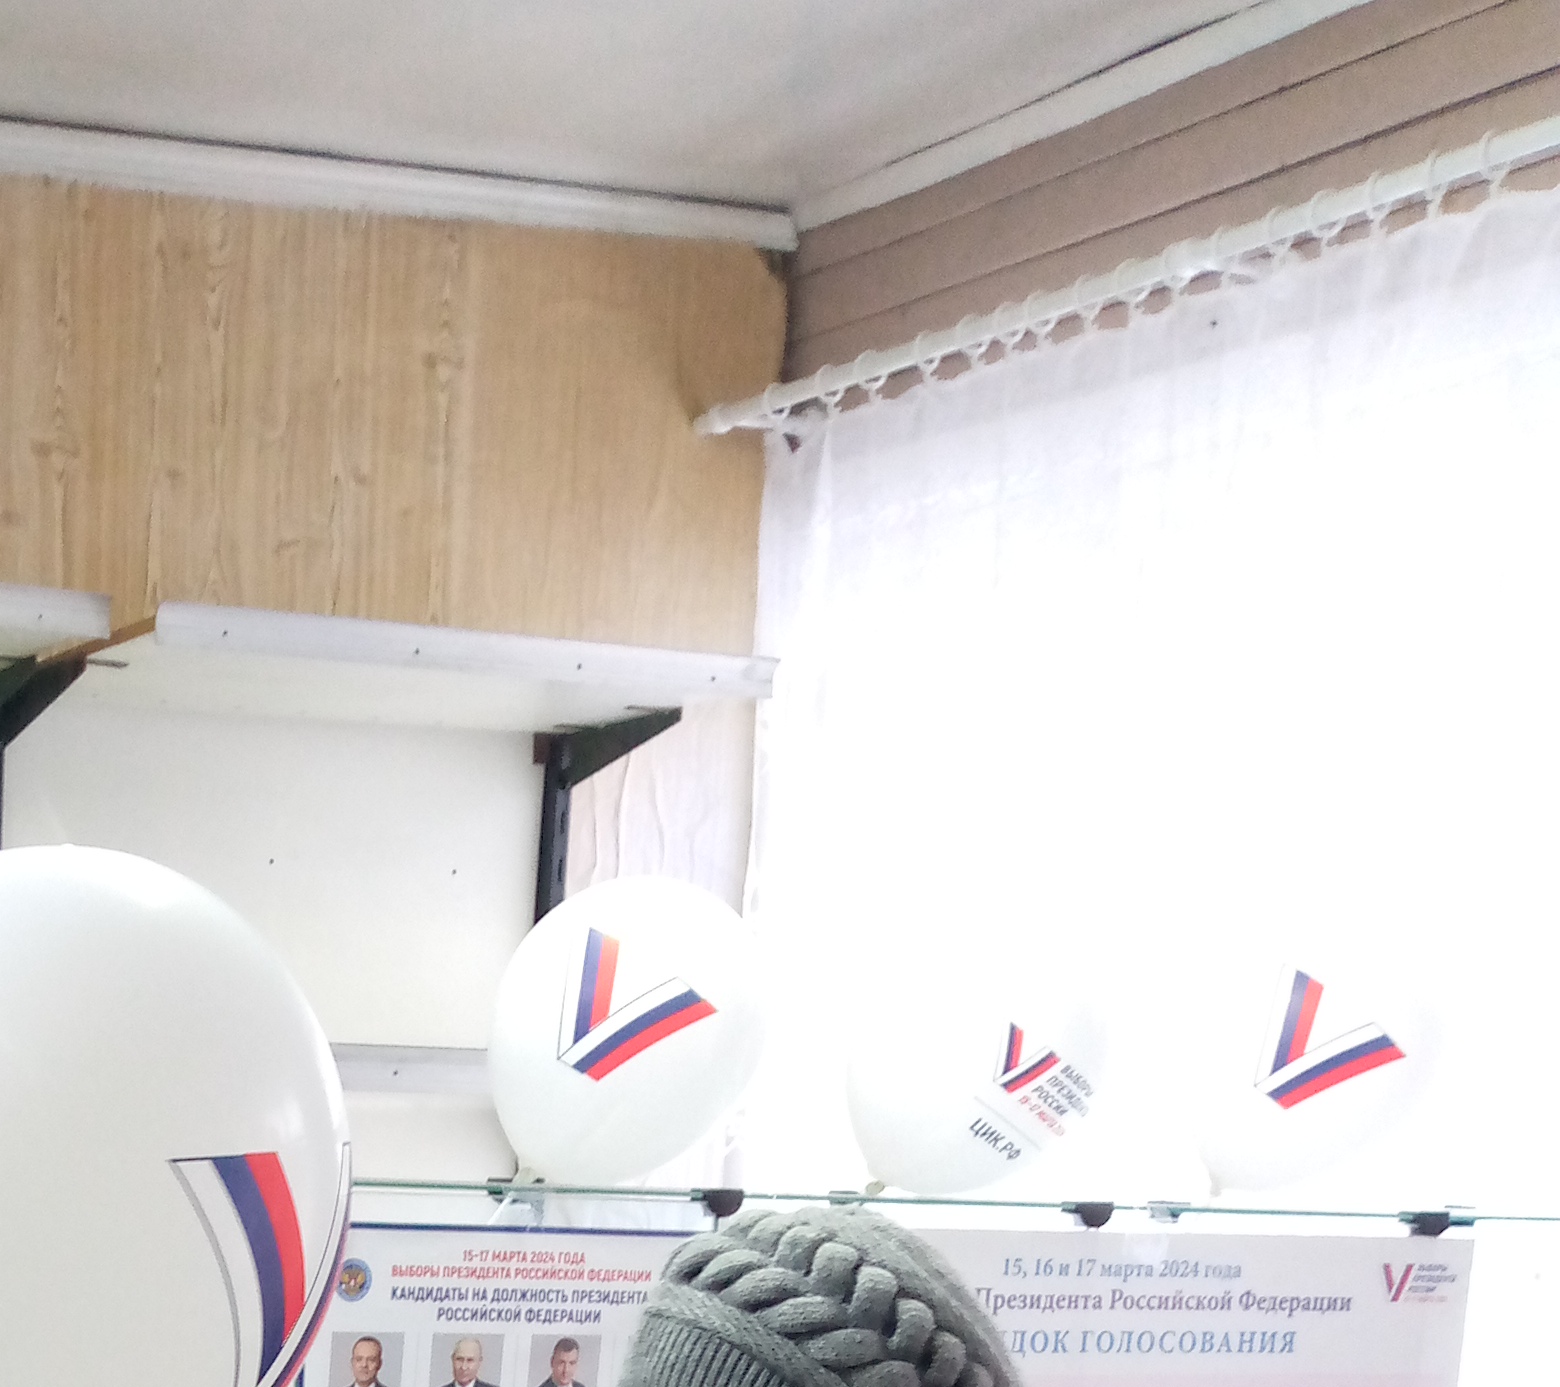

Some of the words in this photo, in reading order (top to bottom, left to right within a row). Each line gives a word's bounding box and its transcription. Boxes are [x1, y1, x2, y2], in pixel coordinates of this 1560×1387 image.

[1031, 1085, 1070, 1117] РОССИИ
[969, 1117, 1023, 1162] ЦИК.РФ
[462, 1249, 489, 1262] 15-17
[491, 1250, 528, 1263] МАРТА
[530, 1251, 556, 1264] 2024
[558, 1251, 586, 1266] ГОДА
[391, 1264, 441, 1278] ВЫБОРЫ
[442, 1265, 512, 1280] ПРЕЗИДЕНТА
[514, 1266, 585, 1281] РОССИЙСКОЙ
[587, 1268, 652, 1284] ФЕДЕРАЦИИ
[1034, 1258, 1054, 1277] 16
[1058, 1263, 1070, 1277] и
[1076, 1258, 1097, 1277] 17
[1100, 1262, 1154, 1283] марта
[1159, 1259, 1200, 1278] 2024
[1204, 1263, 1242, 1280] года
[391, 1285, 469, 1303] КАНДИДАТЫ
[472, 1286, 488, 1302] НА
[490, 1287, 568, 1304] ДОЛЖНОСТЬ
[571, 1289, 649, 1306] ПРЕЗИДЕНТА
[975, 1286, 1103, 1316] Президента
[1108, 1288, 1234, 1311] Российской
[1238, 1289, 1353, 1318] Федерации
[436, 1304, 522, 1323] РОССИЙСКОЙ
[524, 1306, 602, 1325] ФЕДЕРАЦИИ
[1080, 1329, 1298, 1355] ГОЛОСОВАНИЯ
